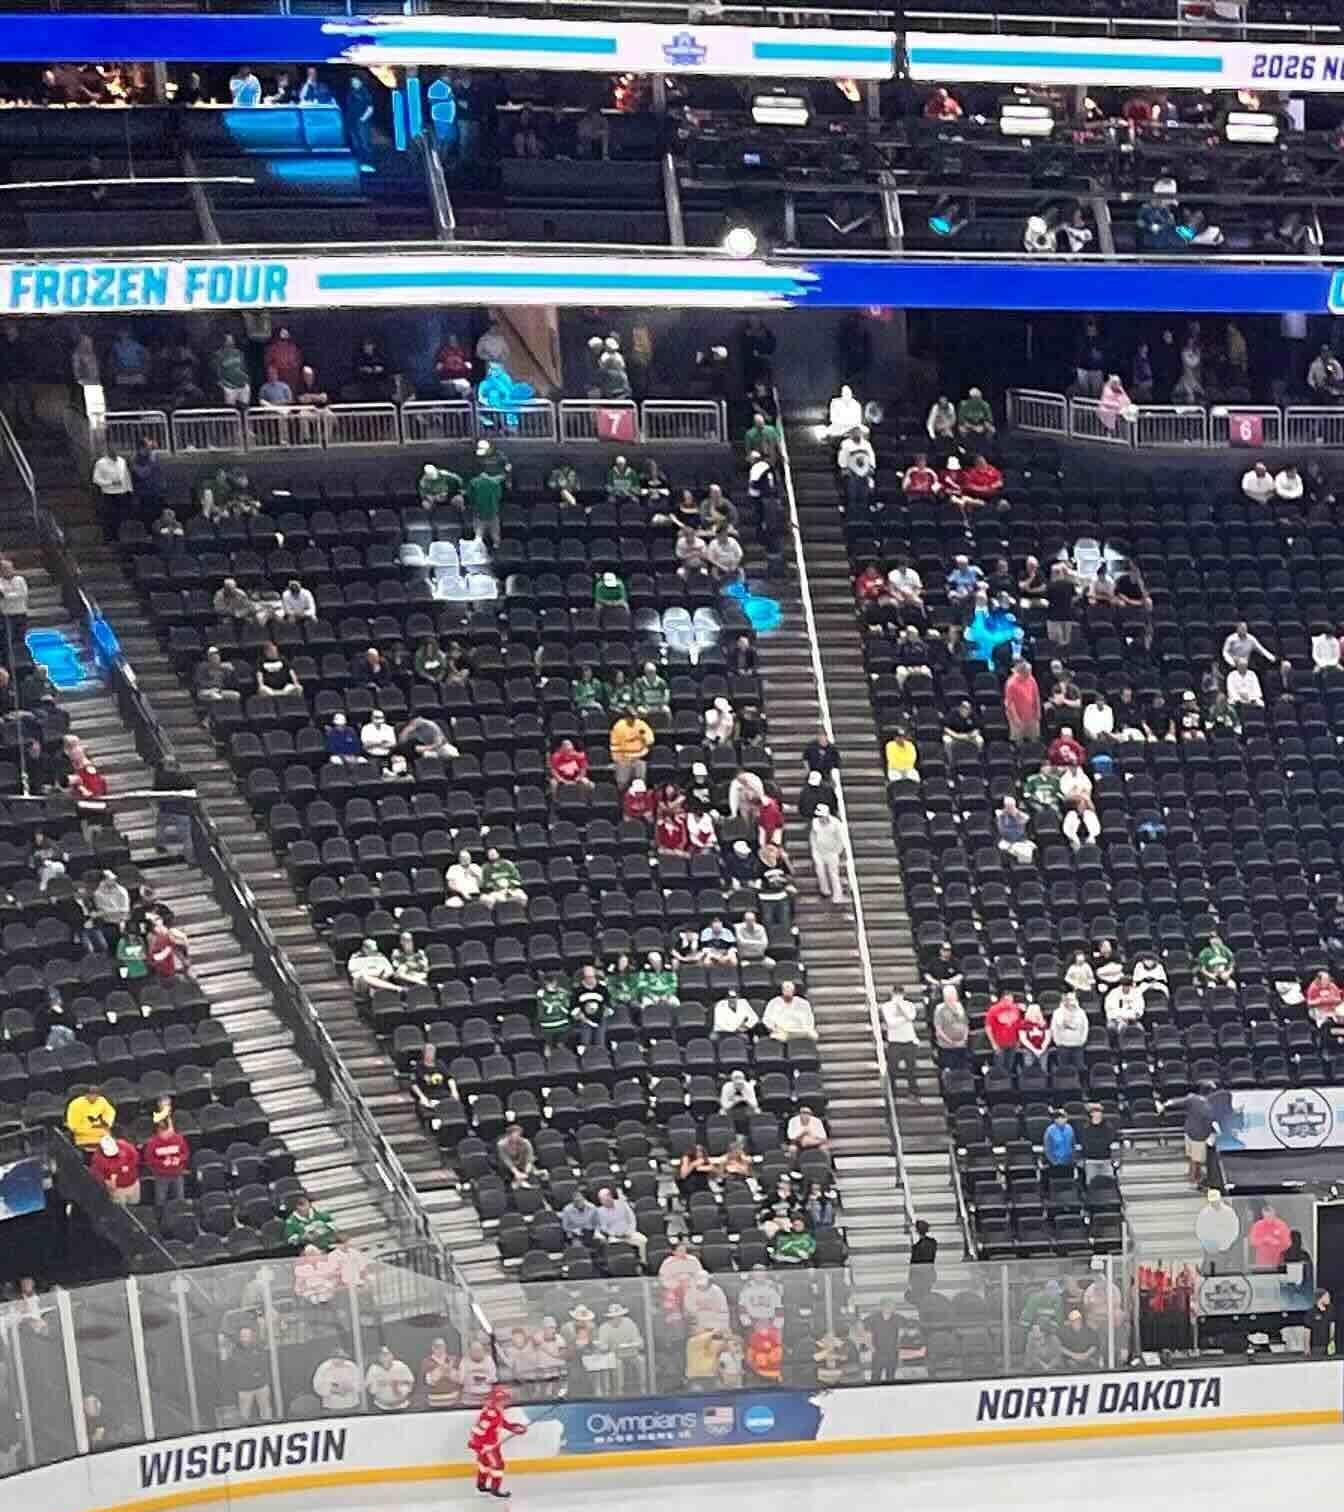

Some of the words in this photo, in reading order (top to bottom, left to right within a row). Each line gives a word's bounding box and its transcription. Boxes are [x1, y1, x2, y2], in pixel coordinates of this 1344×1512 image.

[1252, 54, 1315, 81] 2026
[8, 265, 169, 309] FROZEN
[183, 263, 289, 305] FOUR
[976, 1385, 1089, 1422] NORTH
[1097, 1376, 1222, 1413] DAKOTA
[587, 1410, 697, 1438] Olympians
[139, 1428, 347, 1489] WISCONSIN
